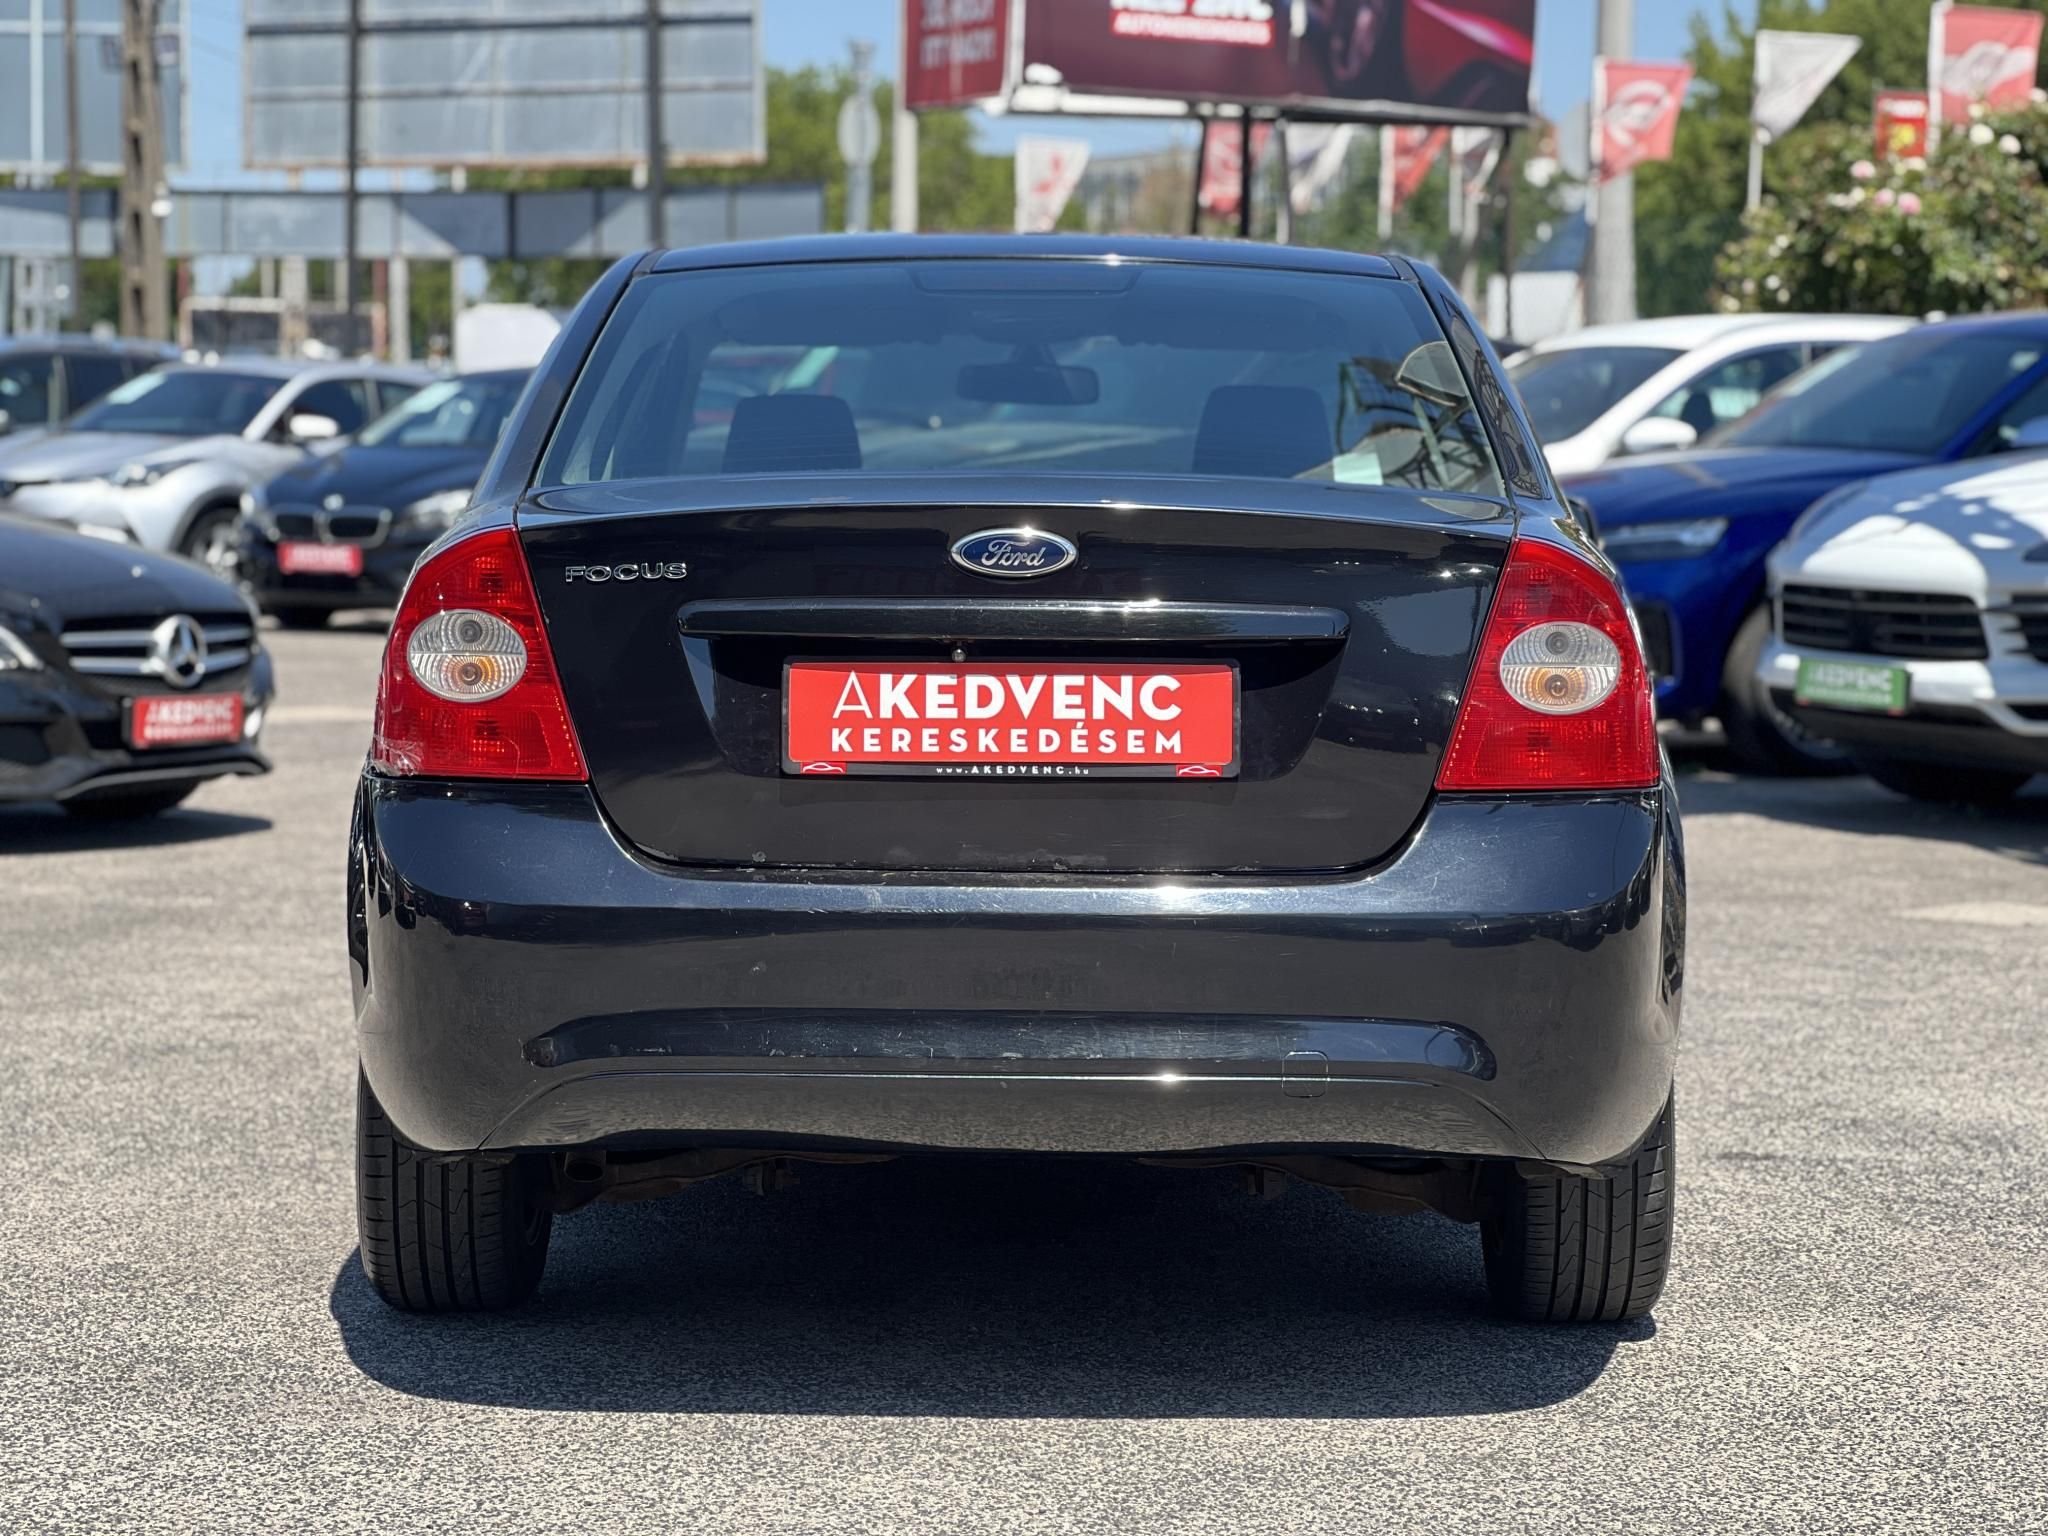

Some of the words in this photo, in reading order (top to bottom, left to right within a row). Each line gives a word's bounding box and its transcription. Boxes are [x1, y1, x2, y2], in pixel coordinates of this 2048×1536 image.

[981, 538, 1045, 568] Ford
[565, 562, 688, 583] FOCUS
[832, 670, 1183, 721] AKEDVENC
[831, 722, 1182, 755] KERESKEDÉSEM
[936, 765, 1090, 775] www.AKEDVENC.hu
